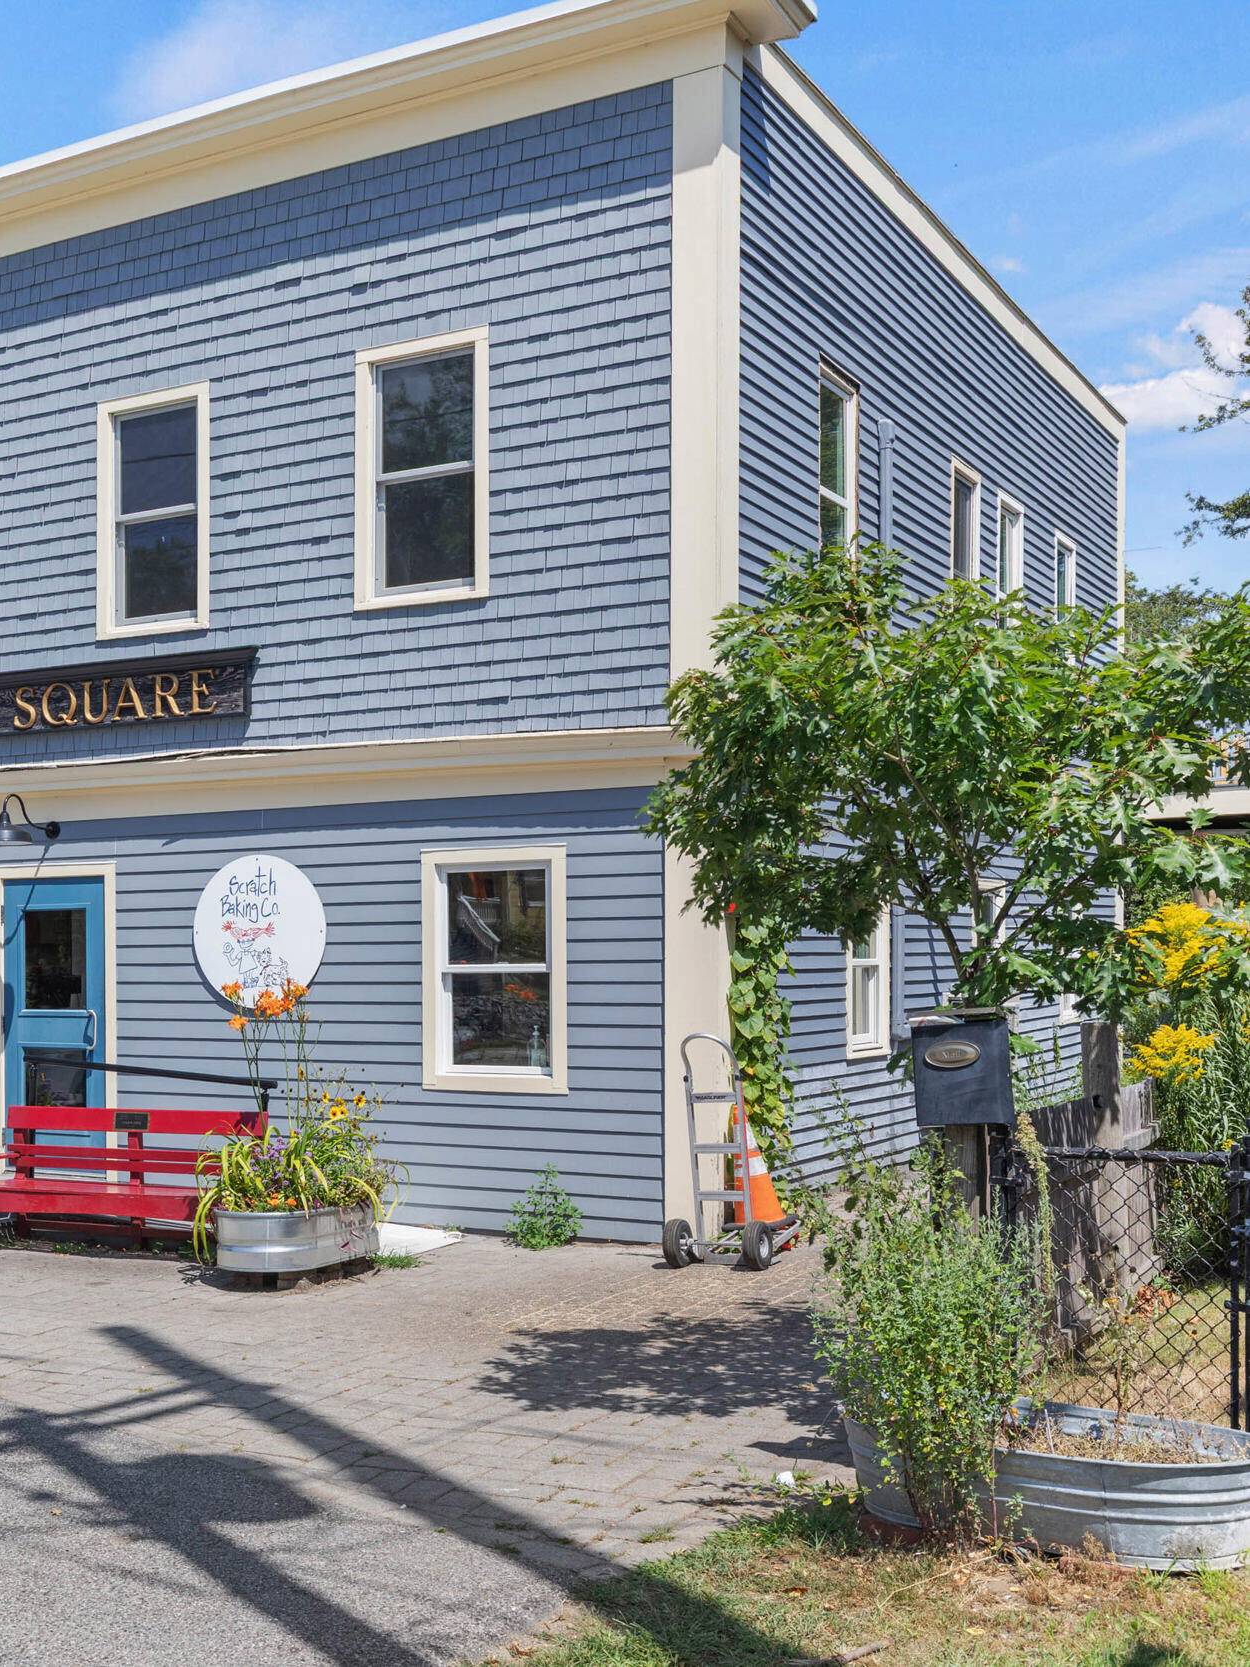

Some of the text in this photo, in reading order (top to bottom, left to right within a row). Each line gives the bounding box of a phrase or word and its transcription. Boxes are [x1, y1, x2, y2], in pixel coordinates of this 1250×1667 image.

[13, 668, 218, 730] SQUARE
[229, 866, 277, 897] Scratch
[220, 895, 281, 923] Baking Co.
